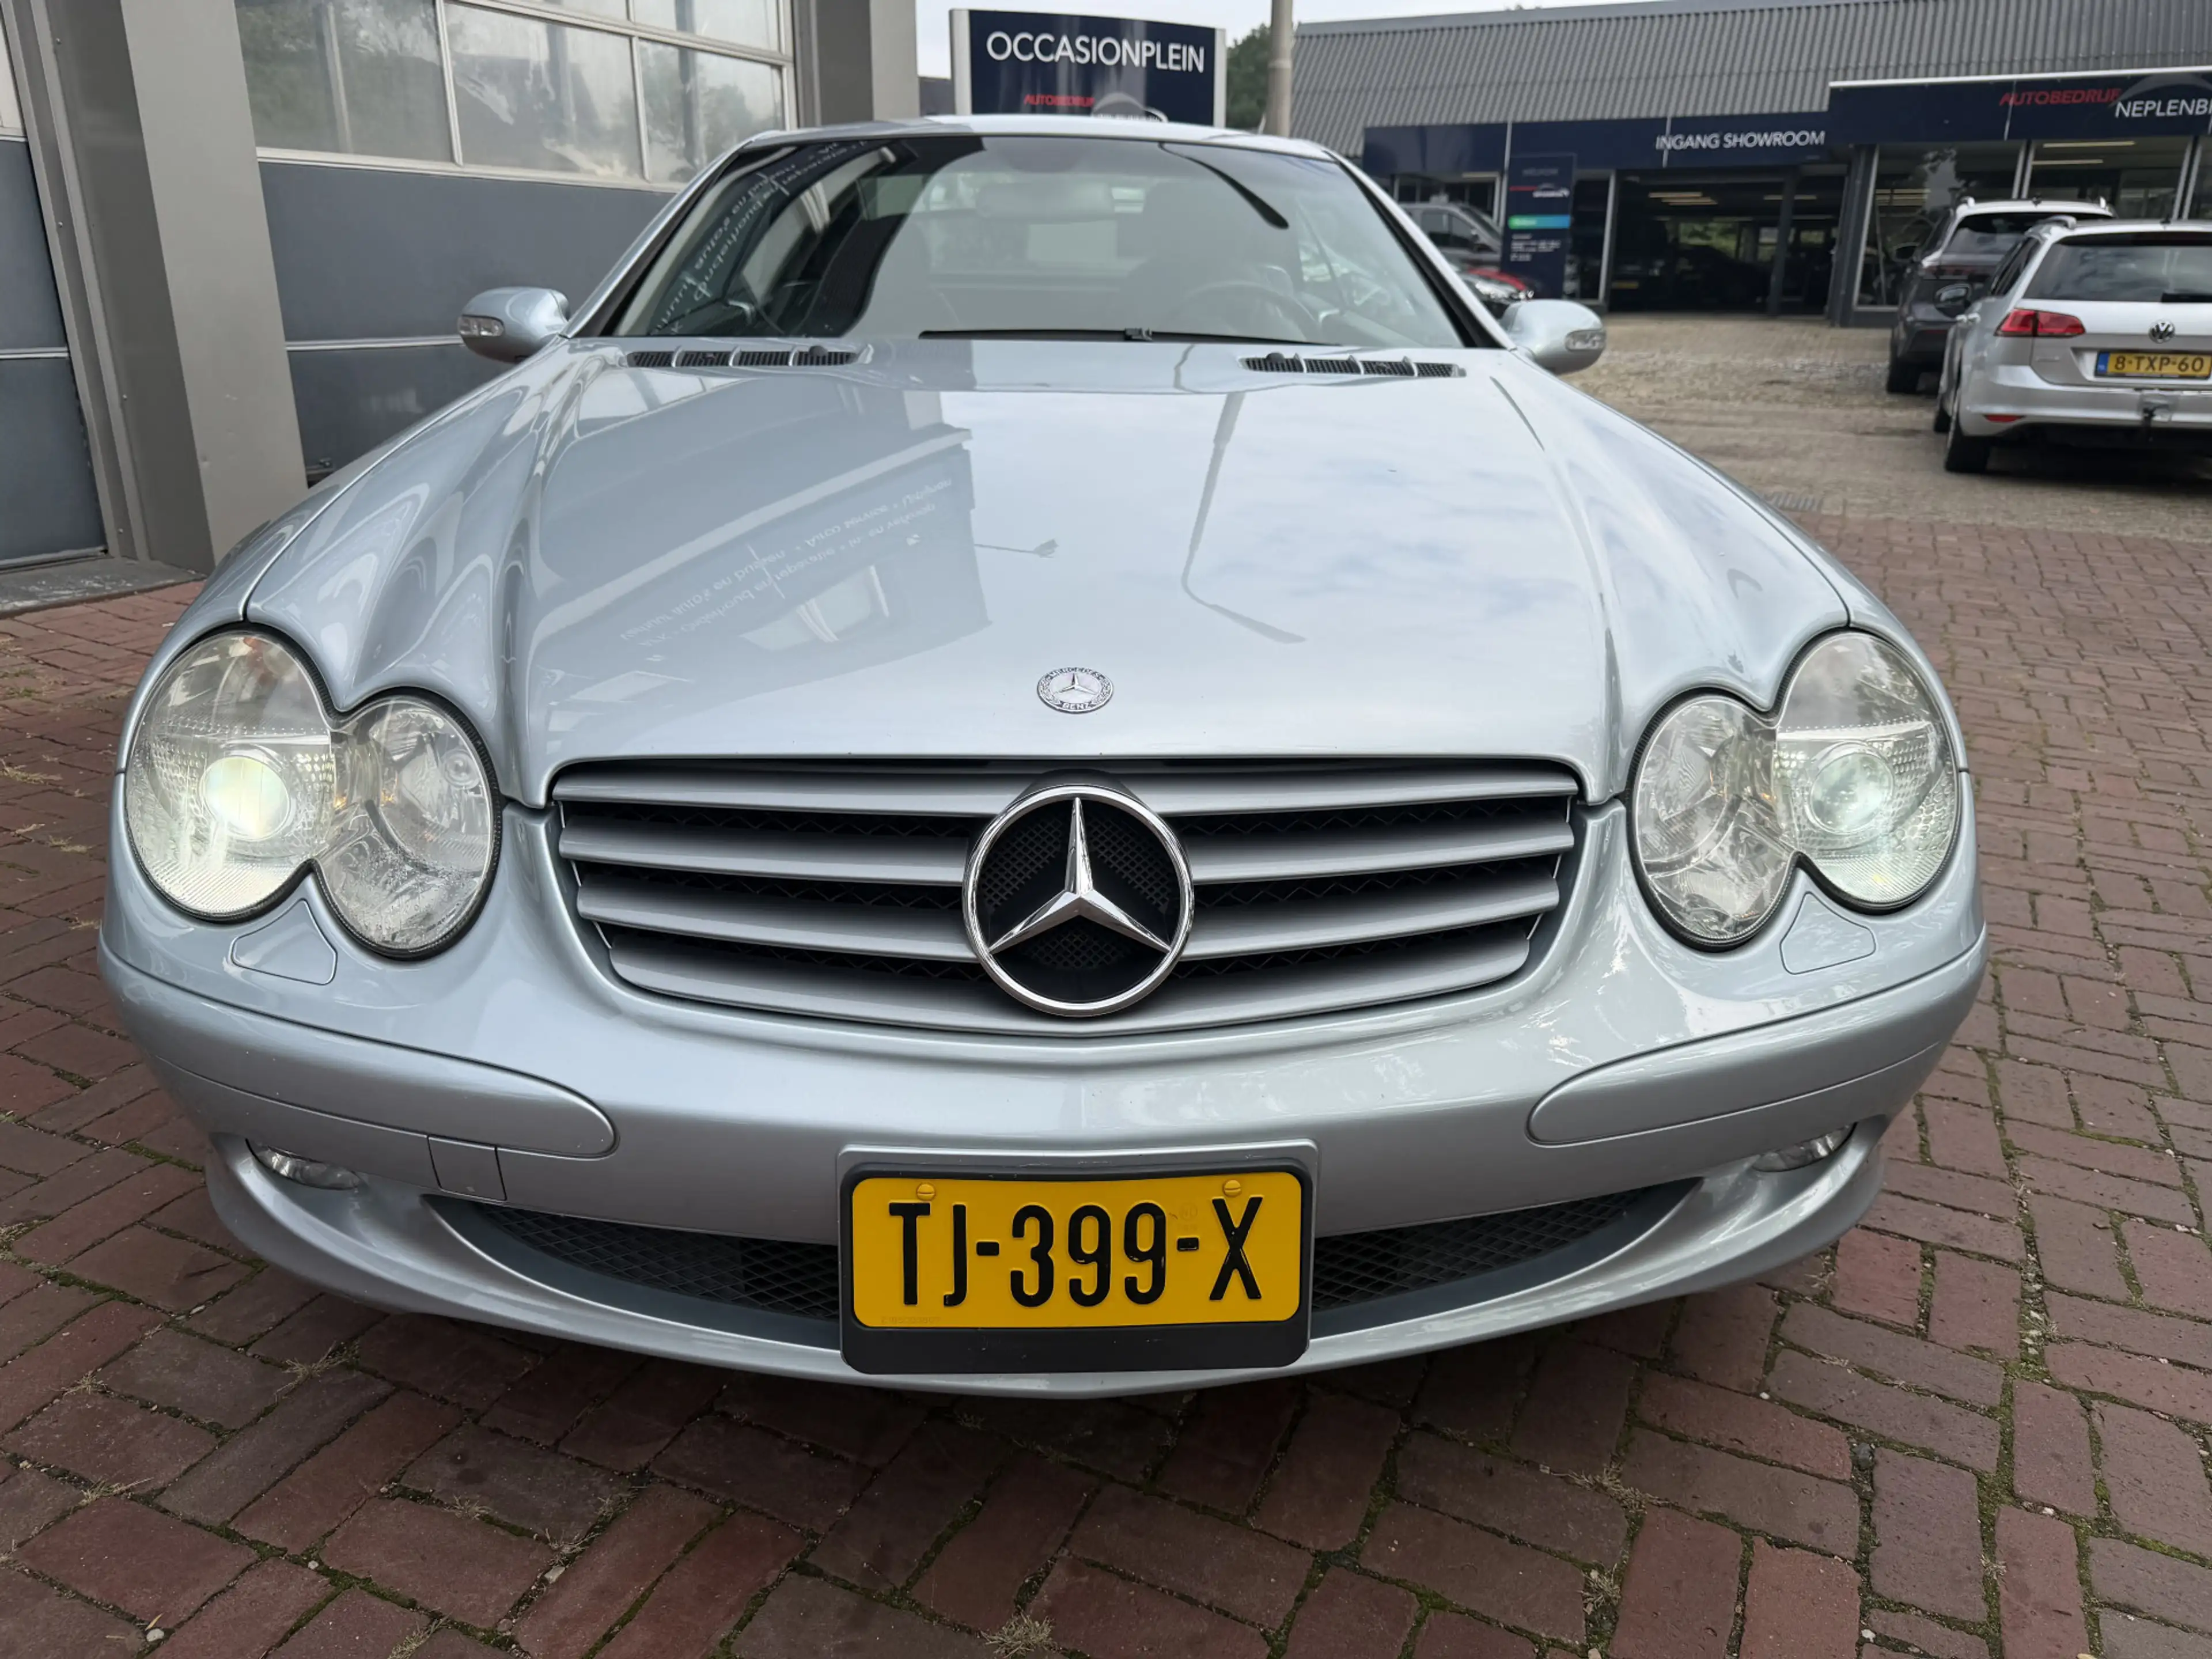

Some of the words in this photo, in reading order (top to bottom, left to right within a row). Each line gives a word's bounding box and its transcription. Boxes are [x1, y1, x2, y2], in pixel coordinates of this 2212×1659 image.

[987, 31, 1205, 73] OCCASIONPLEIN
[1656, 133, 1721, 150] INGANG
[1723, 131, 1826, 148] SHOWROOM
[2114, 355, 2205, 372] 8-TXP-60
[889, 1196, 1263, 1308] TJ-399-X
